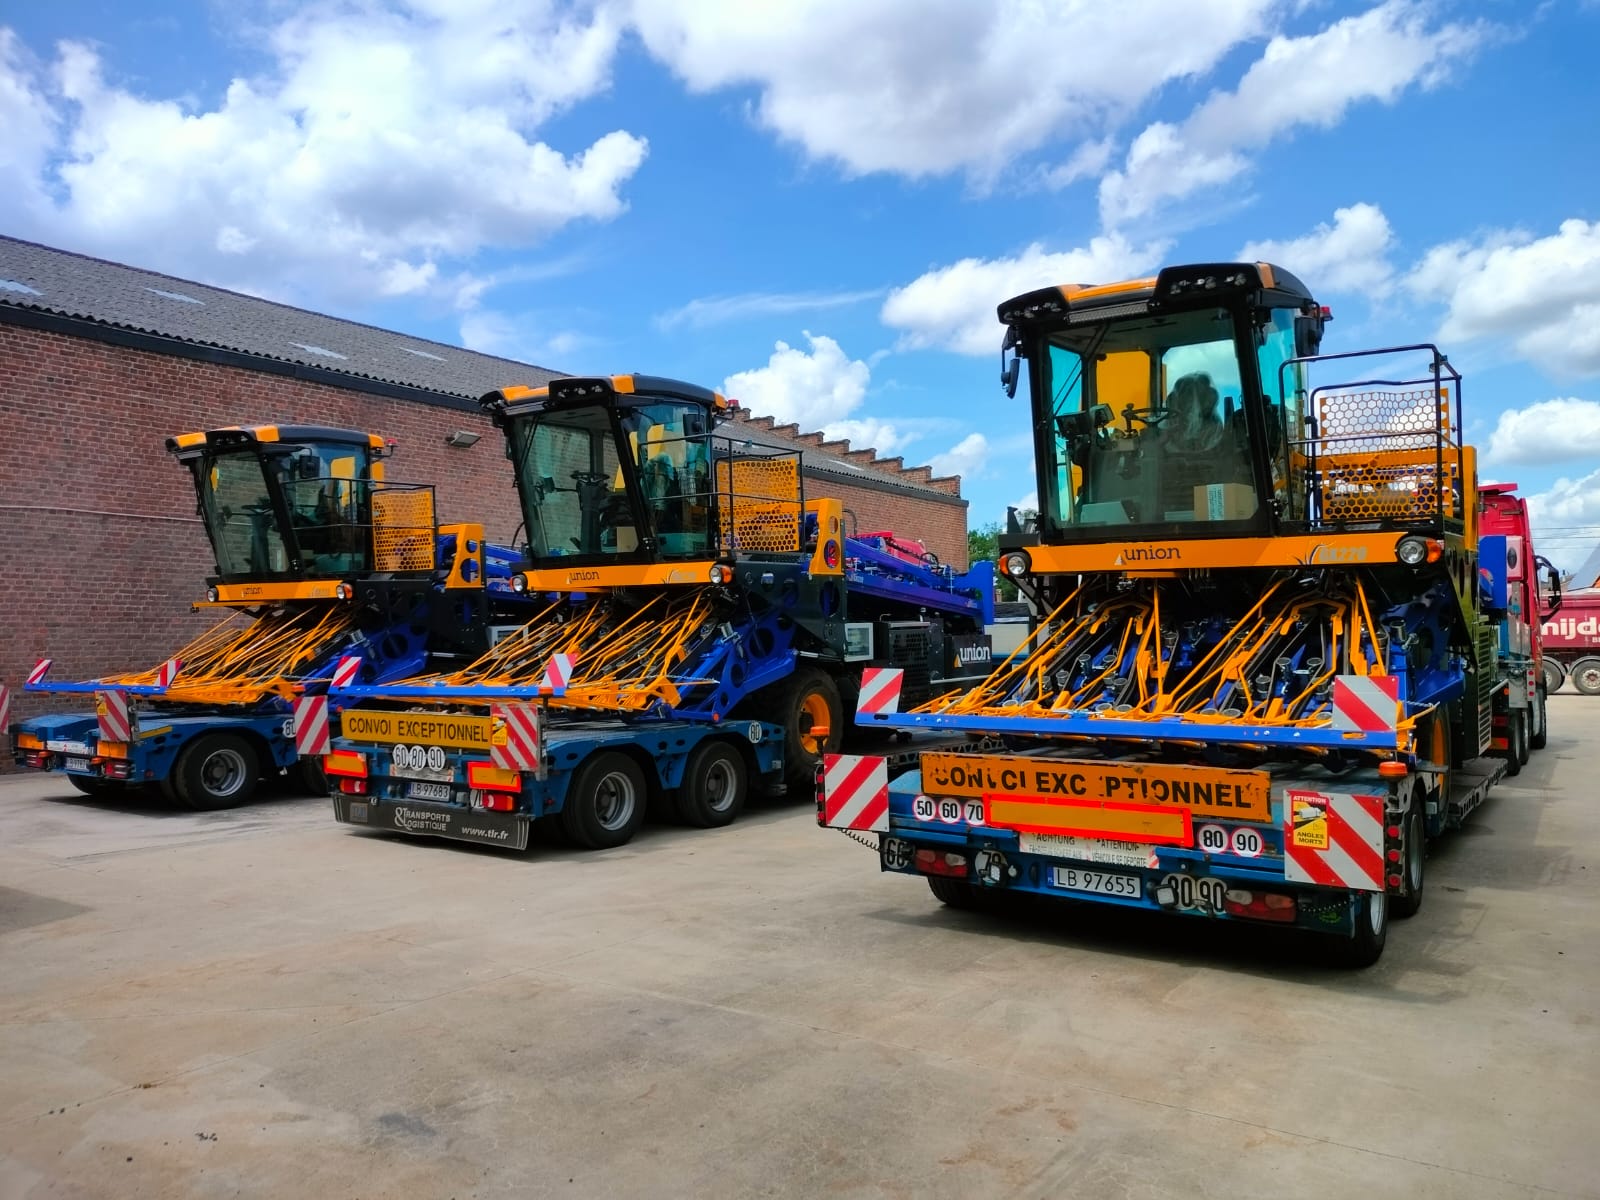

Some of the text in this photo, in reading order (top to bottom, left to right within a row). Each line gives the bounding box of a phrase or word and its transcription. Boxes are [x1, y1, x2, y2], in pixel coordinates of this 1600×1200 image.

[1124, 546, 1181, 561] union
[570, 570, 599, 581] union
[1541, 617, 1600, 640] nijd
[959, 643, 991, 661] union
[349, 717, 392, 735] CONVOI
[397, 720, 489, 743] EXCEPTIONNEL
[395, 746, 442, 769] 60 80 90
[412, 783, 449, 798] LB 97683
[1036, 771, 1252, 809] EXCPTIONNEL
[402, 807, 451, 823] TRANSPORTS
[916, 800, 984, 821] 50 60 70
[404, 818, 447, 831] LOGISTIQUE
[1036, 833, 1076, 846] ACHTUNG
[1203, 830, 1258, 852] 80 90
[1057, 868, 1136, 895] LB 97655
